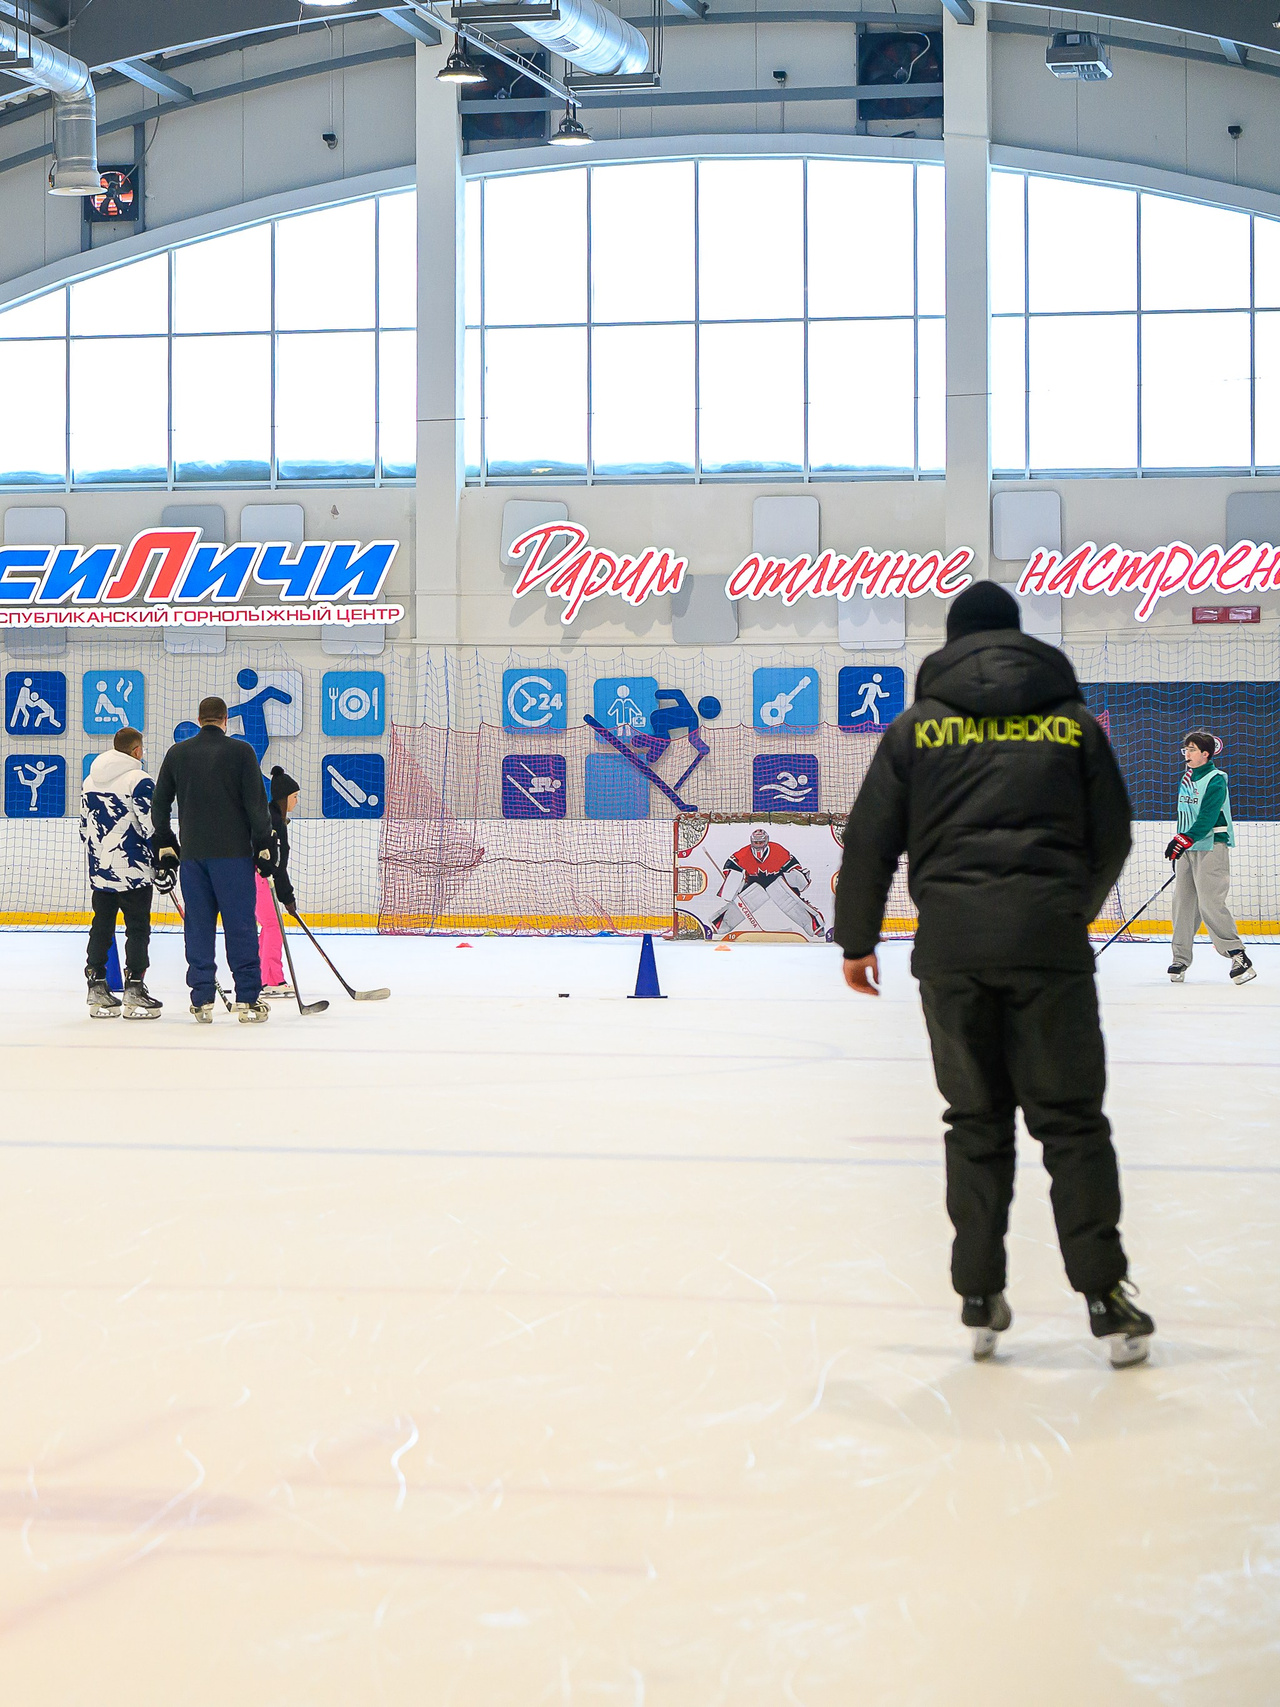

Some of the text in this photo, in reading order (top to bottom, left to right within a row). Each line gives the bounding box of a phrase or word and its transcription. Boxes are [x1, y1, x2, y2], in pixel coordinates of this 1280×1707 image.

[511, 525, 1280, 621] Дарим отличное настроен
[173, 606, 331, 622] ГОРНОЛЫЖНЫЙ
[336, 608, 401, 623] ЦЕНТР
[537, 693, 563, 711] 24
[914, 714, 1083, 748] КУПАЛОВСКОЕ
[741, 907, 758, 929] CANADA
